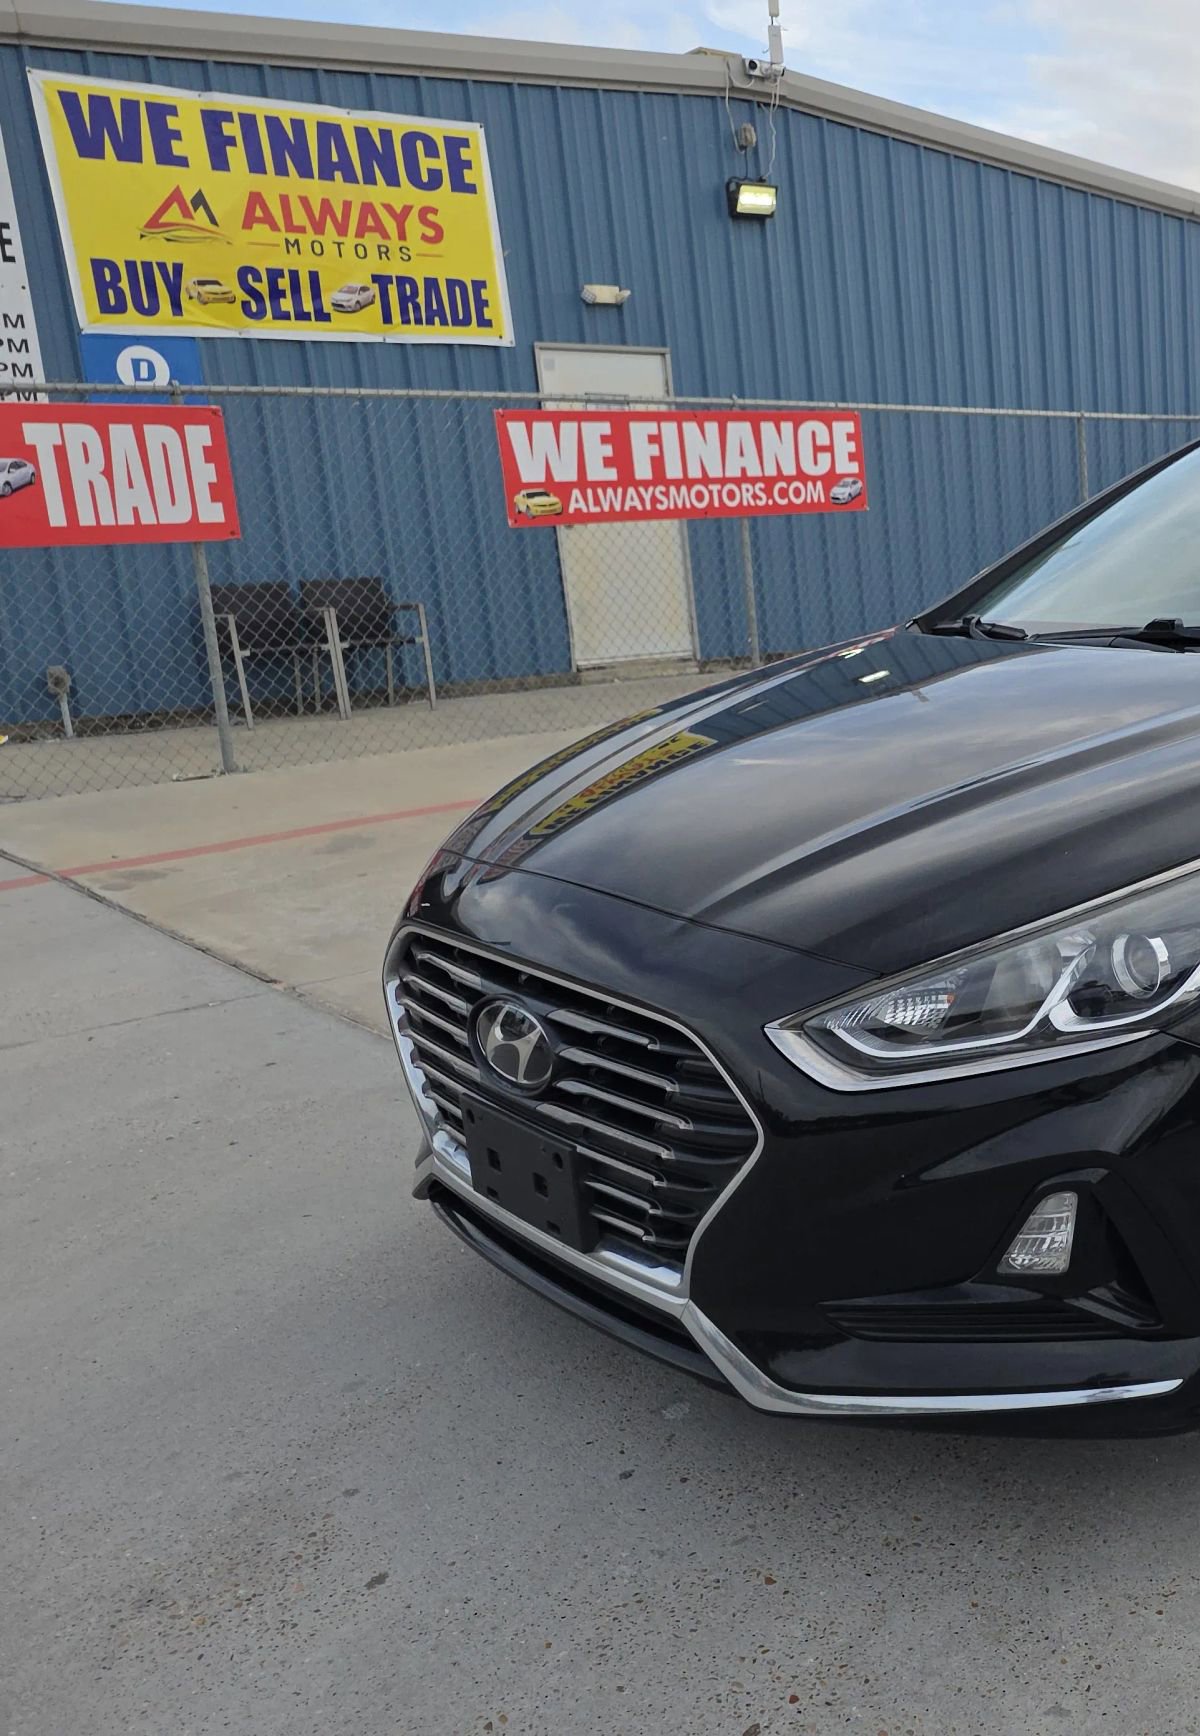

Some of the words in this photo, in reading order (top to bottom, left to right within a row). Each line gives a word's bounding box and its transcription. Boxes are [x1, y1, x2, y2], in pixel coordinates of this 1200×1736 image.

[57, 90, 190, 168] WE
[200, 109, 477, 195] FINANCE
[241, 191, 445, 245] ALWAYS
[285, 237, 413, 263] MOTORS
[90, 258, 184, 317] BUY
[237, 265, 332, 322] SELL
[371, 274, 494, 329] TRADE
[22, 423, 226, 527] TRADE
[506, 421, 618, 483] WE
[629, 420, 860, 481] FINANCE
[568, 480, 825, 514] ALWAYSMOTORS.COM
